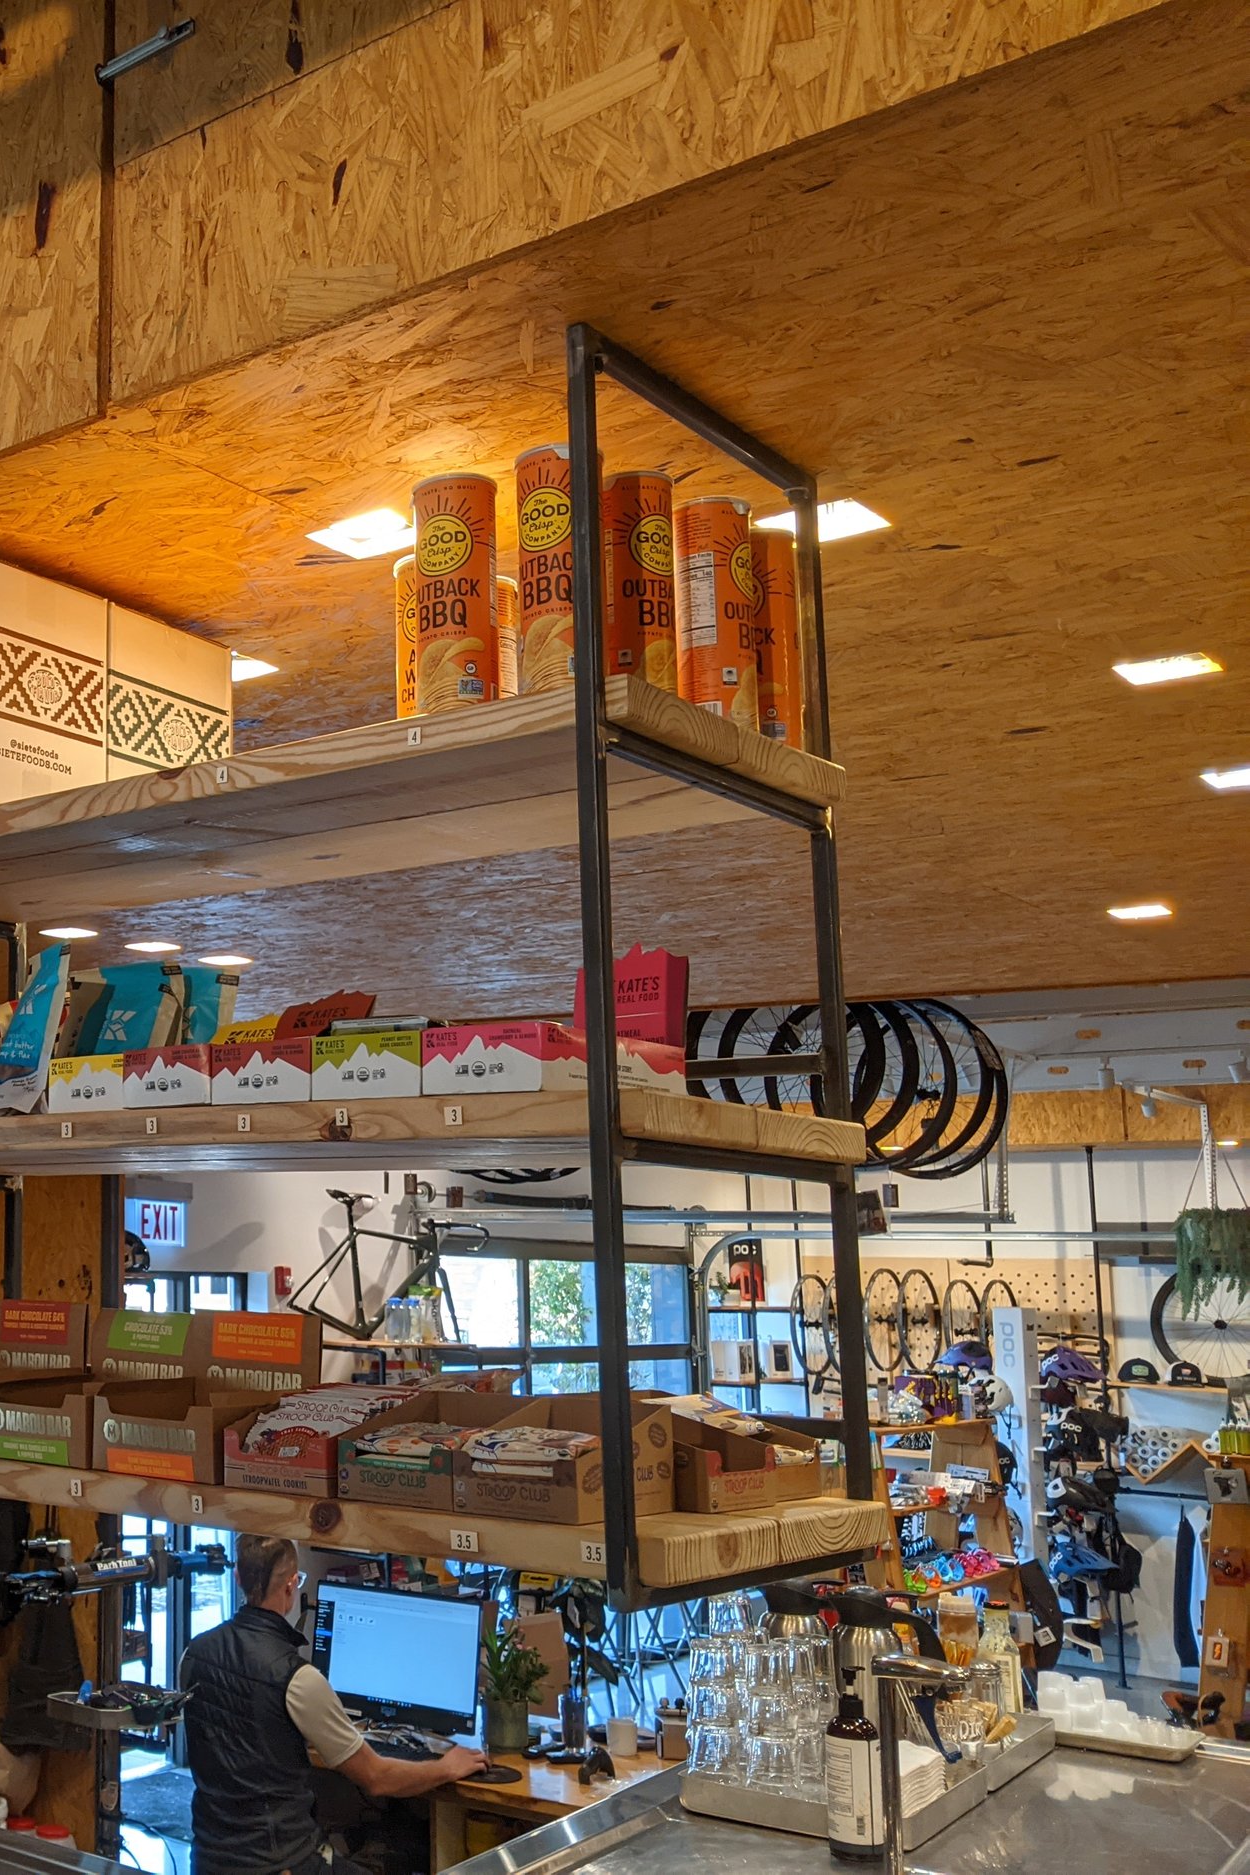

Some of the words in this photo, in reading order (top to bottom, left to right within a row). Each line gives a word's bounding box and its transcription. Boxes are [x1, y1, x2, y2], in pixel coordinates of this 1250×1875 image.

[534, 499, 548, 507] The
[521, 503, 569, 526] GOOD
[432, 525, 446, 533] The
[529, 519, 555, 533] Crisp
[654, 523, 666, 532] The
[420, 530, 467, 550] GOOD
[525, 525, 563, 543] COMPANY
[636, 531, 672, 547] GOO
[427, 546, 453, 558] Crisp
[423, 551, 461, 568] COMPANY
[521, 551, 573, 581] UTBAC
[418, 577, 481, 605] UTBACK
[523, 573, 574, 611] BBQ
[419, 598, 467, 634] BBQ
[411, 731, 417, 743] 4
[10, 739, 59, 761] @sietefoods
[219, 770, 225, 781] 4
[618, 976, 660, 994] KATE'S
[617, 994, 636, 1003] REAL
[638, 993, 659, 1002] FOOD
[313, 1008, 348, 1018] KATE'S
[243, 1028, 276, 1038] KATE'S
[436, 1032, 457, 1041] KATE'S
[617, 1029, 641, 1037] ATMEAL
[325, 1040, 345, 1049] KATE'S
[58, 1061, 73, 1070] KATE'S
[339, 1110, 344, 1124] 3
[451, 1109, 458, 1123] 3
[64, 1124, 69, 1136] 3
[149, 1120, 155, 1131] 3
[241, 1117, 246, 1130] 3
[141, 1203, 178, 1241] EXIT
[5, 1310, 20, 1321] DARK
[20, 1311, 52, 1322] CHOCOLATE
[52, 1312, 65, 1323] 64%
[124, 1321, 159, 1334] CHOCOLATE
[218, 1322, 238, 1334] DARK
[238, 1323, 279, 1337] CHOCOLATE
[12, 1352, 50, 1368] MAROU
[50, 1354, 71, 1368] BAR
[118, 1360, 159, 1378] MAROU
[159, 1364, 184, 1378] BAR
[225, 1367, 272, 1391] MAROU
[274, 1372, 302, 1390] BAR
[295, 1400, 328, 1412] STROOP
[276, 1412, 311, 1421] STROOP
[6, 1410, 45, 1435] MAROU
[46, 1415, 71, 1438] BAR
[360, 1470, 396, 1487] STROOP
[398, 1472, 427, 1488] CLUB
[636, 1465, 654, 1482] CLUB
[73, 1482, 79, 1495] 3
[242, 1474, 281, 1488] STROOPWAFEL
[283, 1478, 308, 1490] COOKIES
[725, 1478, 748, 1494] STROOP
[748, 1477, 765, 1490] CLUB
[476, 1483, 517, 1502] STROOP
[519, 1486, 551, 1503] CLUB
[194, 1498, 200, 1511] 3
[456, 1533, 472, 1550] 3.5
[586, 1545, 603, 1561] 3.5
